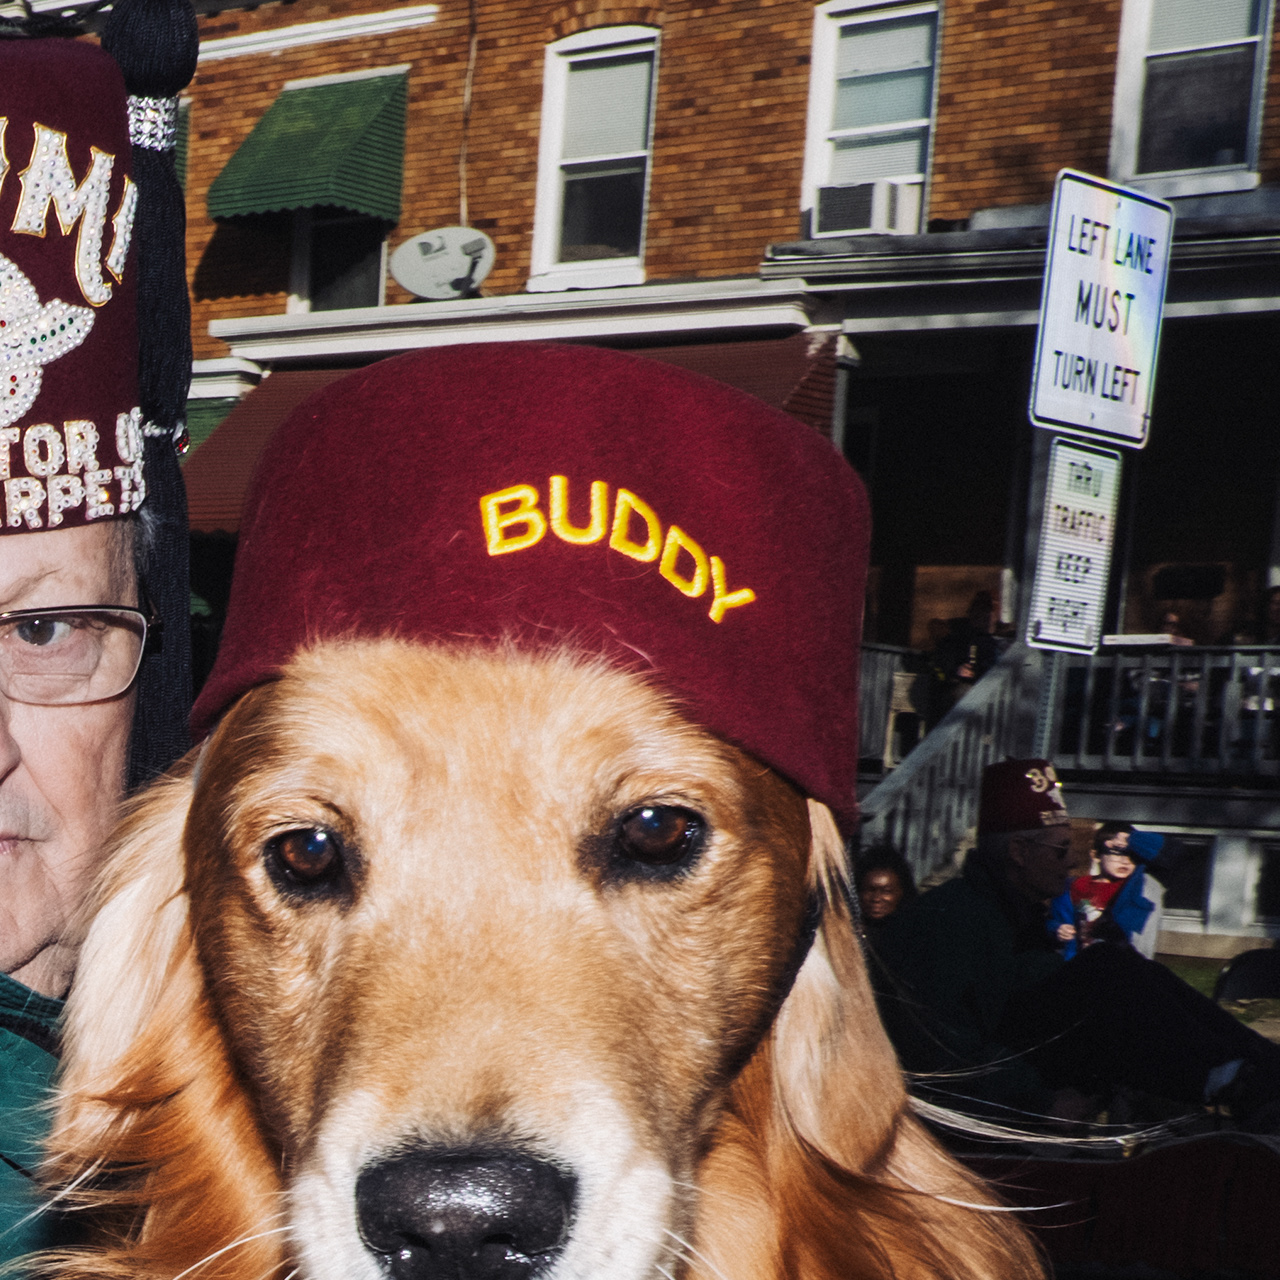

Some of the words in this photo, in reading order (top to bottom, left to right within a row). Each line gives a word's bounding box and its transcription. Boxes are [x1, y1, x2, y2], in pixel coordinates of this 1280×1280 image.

[1067, 214, 1111, 261] LEFT
[1113, 228, 1157, 275] LANE
[1074, 279, 1136, 336] MUST
[1053, 349, 1099, 396] TURN
[1100, 362, 1142, 406] LEFT
[1067, 461, 1104, 498] THRU
[479, 474, 757, 624] BUDDY
[1053, 503, 1106, 543] TRAFFIC
[1055, 552, 1091, 585] KEEP
